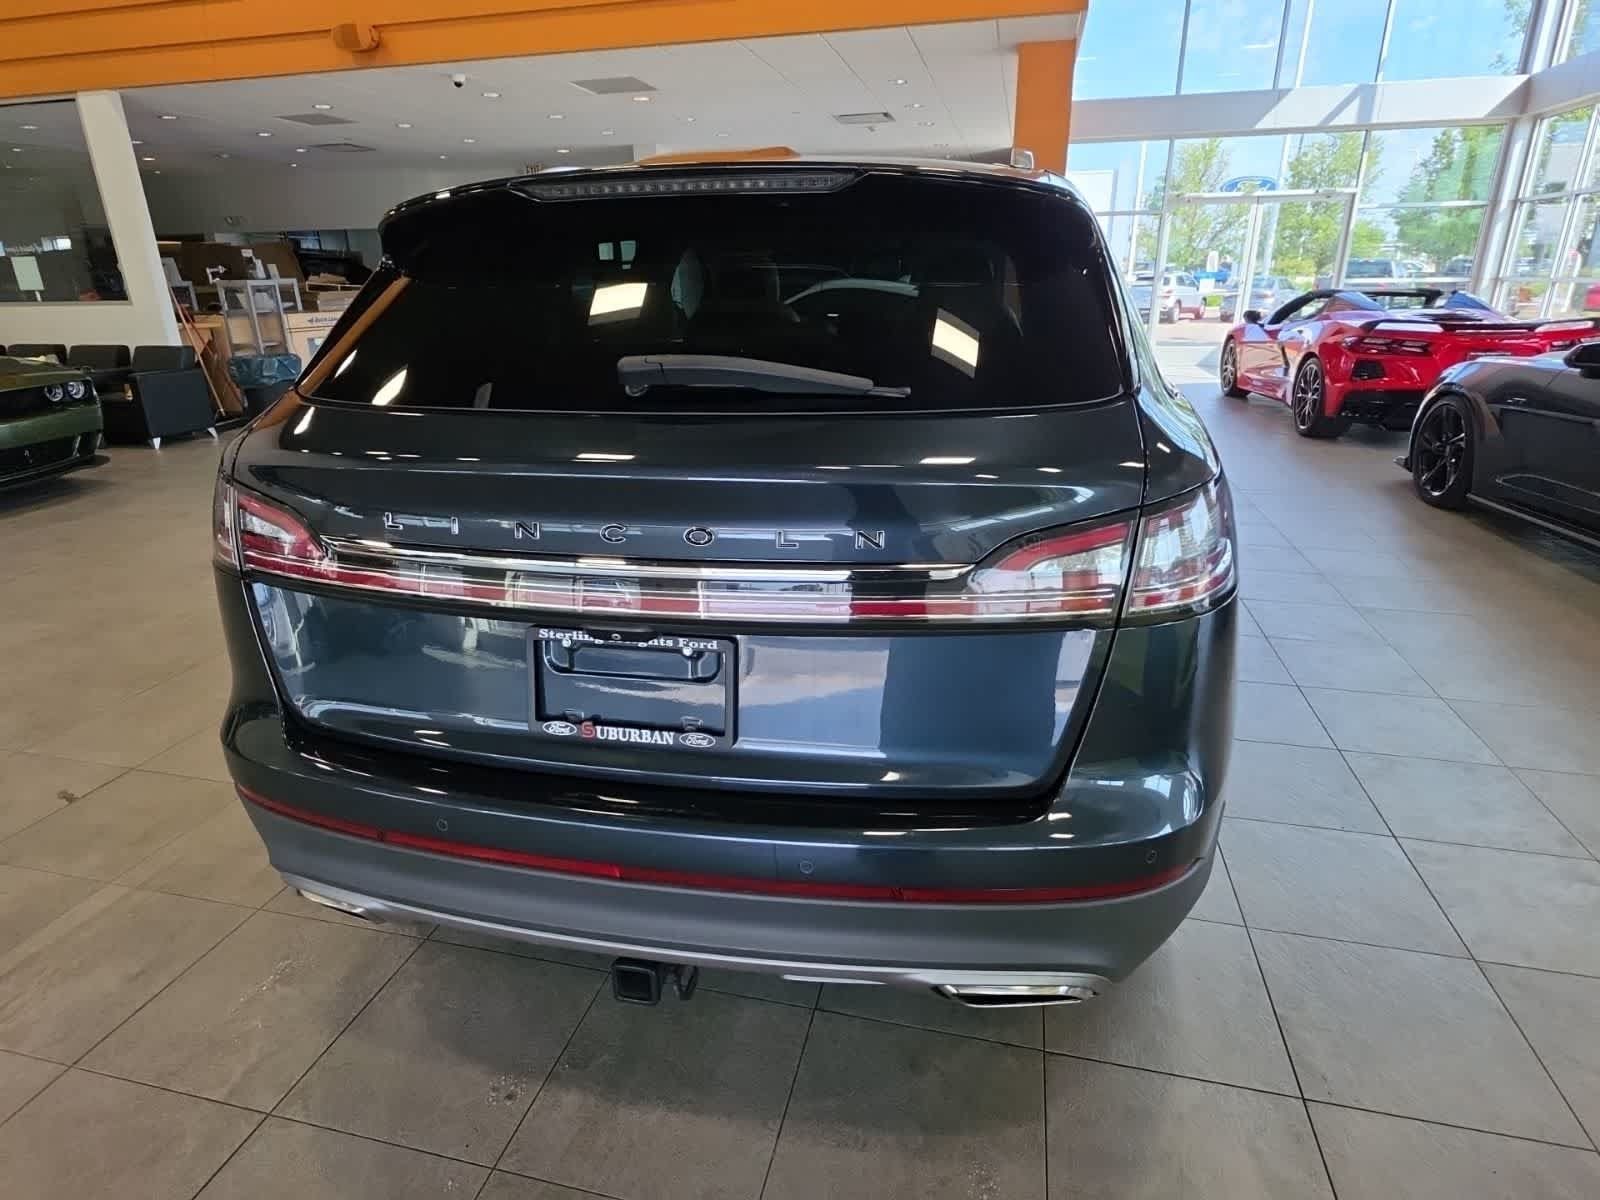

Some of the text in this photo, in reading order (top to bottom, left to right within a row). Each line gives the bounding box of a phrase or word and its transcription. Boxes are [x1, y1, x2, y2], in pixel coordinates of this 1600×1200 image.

[383, 511, 886, 550] LINCOLN
[677, 637, 718, 650] Ford
[547, 720, 711, 747] Ford SUBURBAN Ford
